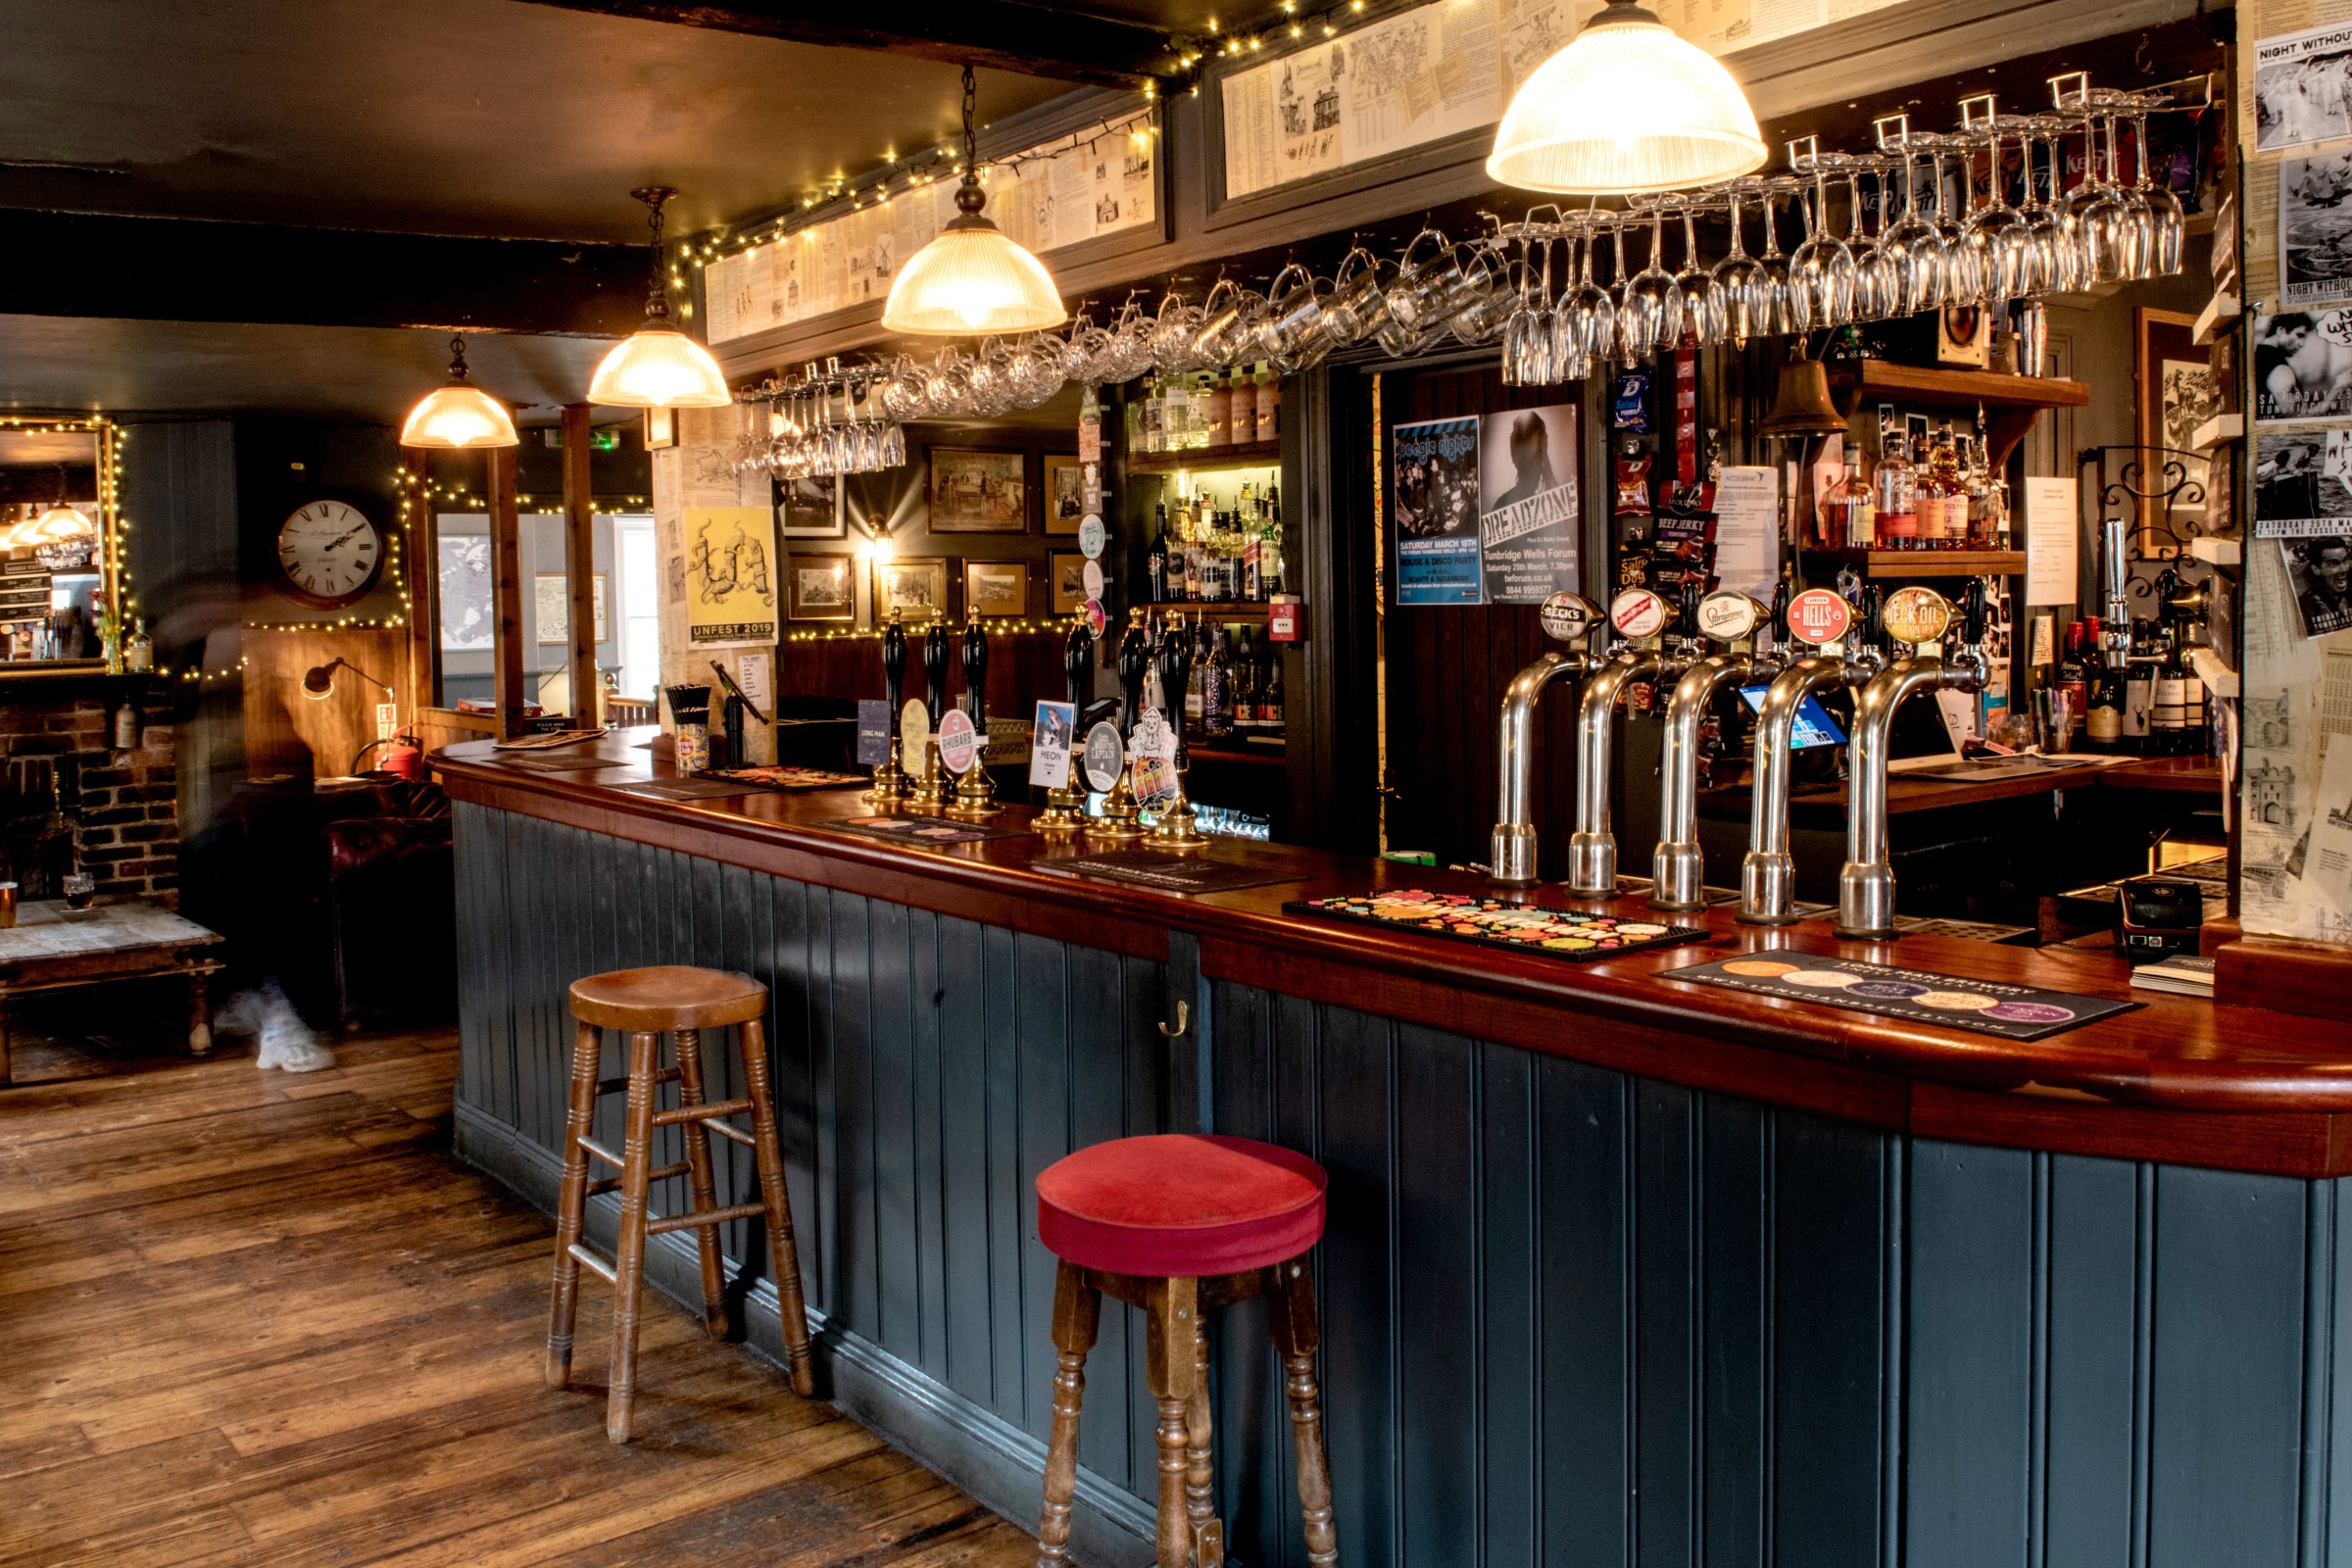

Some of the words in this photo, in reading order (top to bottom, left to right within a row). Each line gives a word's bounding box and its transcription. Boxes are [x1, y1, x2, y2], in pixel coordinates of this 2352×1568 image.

[2260, 44, 2296, 59] NIGHT
[2302, 31, 2352, 50] WITHOU
[2287, 283, 2314, 296] NIGHT
[2259, 390, 2328, 405] SATURDAY
[1399, 438, 1436, 466] boogie
[1438, 434, 1475, 462] nights
[1482, 484, 1577, 545] DREADZONE
[1658, 518, 1678, 529] BEEF
[1677, 519, 1705, 531] JERKY
[2259, 520, 2304, 529] SATURDAY
[1434, 540, 1459, 548] MARCH
[1400, 558, 1423, 566] HOUSE
[1432, 557, 1452, 565] DISCO
[1454, 556, 1476, 564] PARTY
[1484, 551, 1521, 562] Tunbridge
[1523, 550, 1545, 559] Wells
[1548, 549, 1576, 558] Forum
[1486, 564, 1511, 573] Saturday
[1513, 563, 1526, 571] 25th
[1527, 563, 1548, 571] March,
[1550, 562, 1574, 571] 7.30pm
[1621, 558, 1647, 572] Salty
[1621, 572, 1646, 585] Dog
[1545, 606, 1580, 620] BECK'S
[1707, 607, 1744, 628] Staropramen
[1803, 606, 1831, 627] HELLS
[1886, 606, 1916, 624] NECK
[1919, 606, 1939, 624] OIL
[693, 625, 739, 635] UNFEST
[745, 623, 771, 633] 2019
[1549, 621, 1573, 631] VIER
[942, 732, 972, 752] RHUBARB
[1041, 750, 1062, 761] MEON
[1839, 962, 1892, 972] LONG
[1895, 970, 1940, 980] MAN
[1943, 978, 2036, 994] BREWERY
